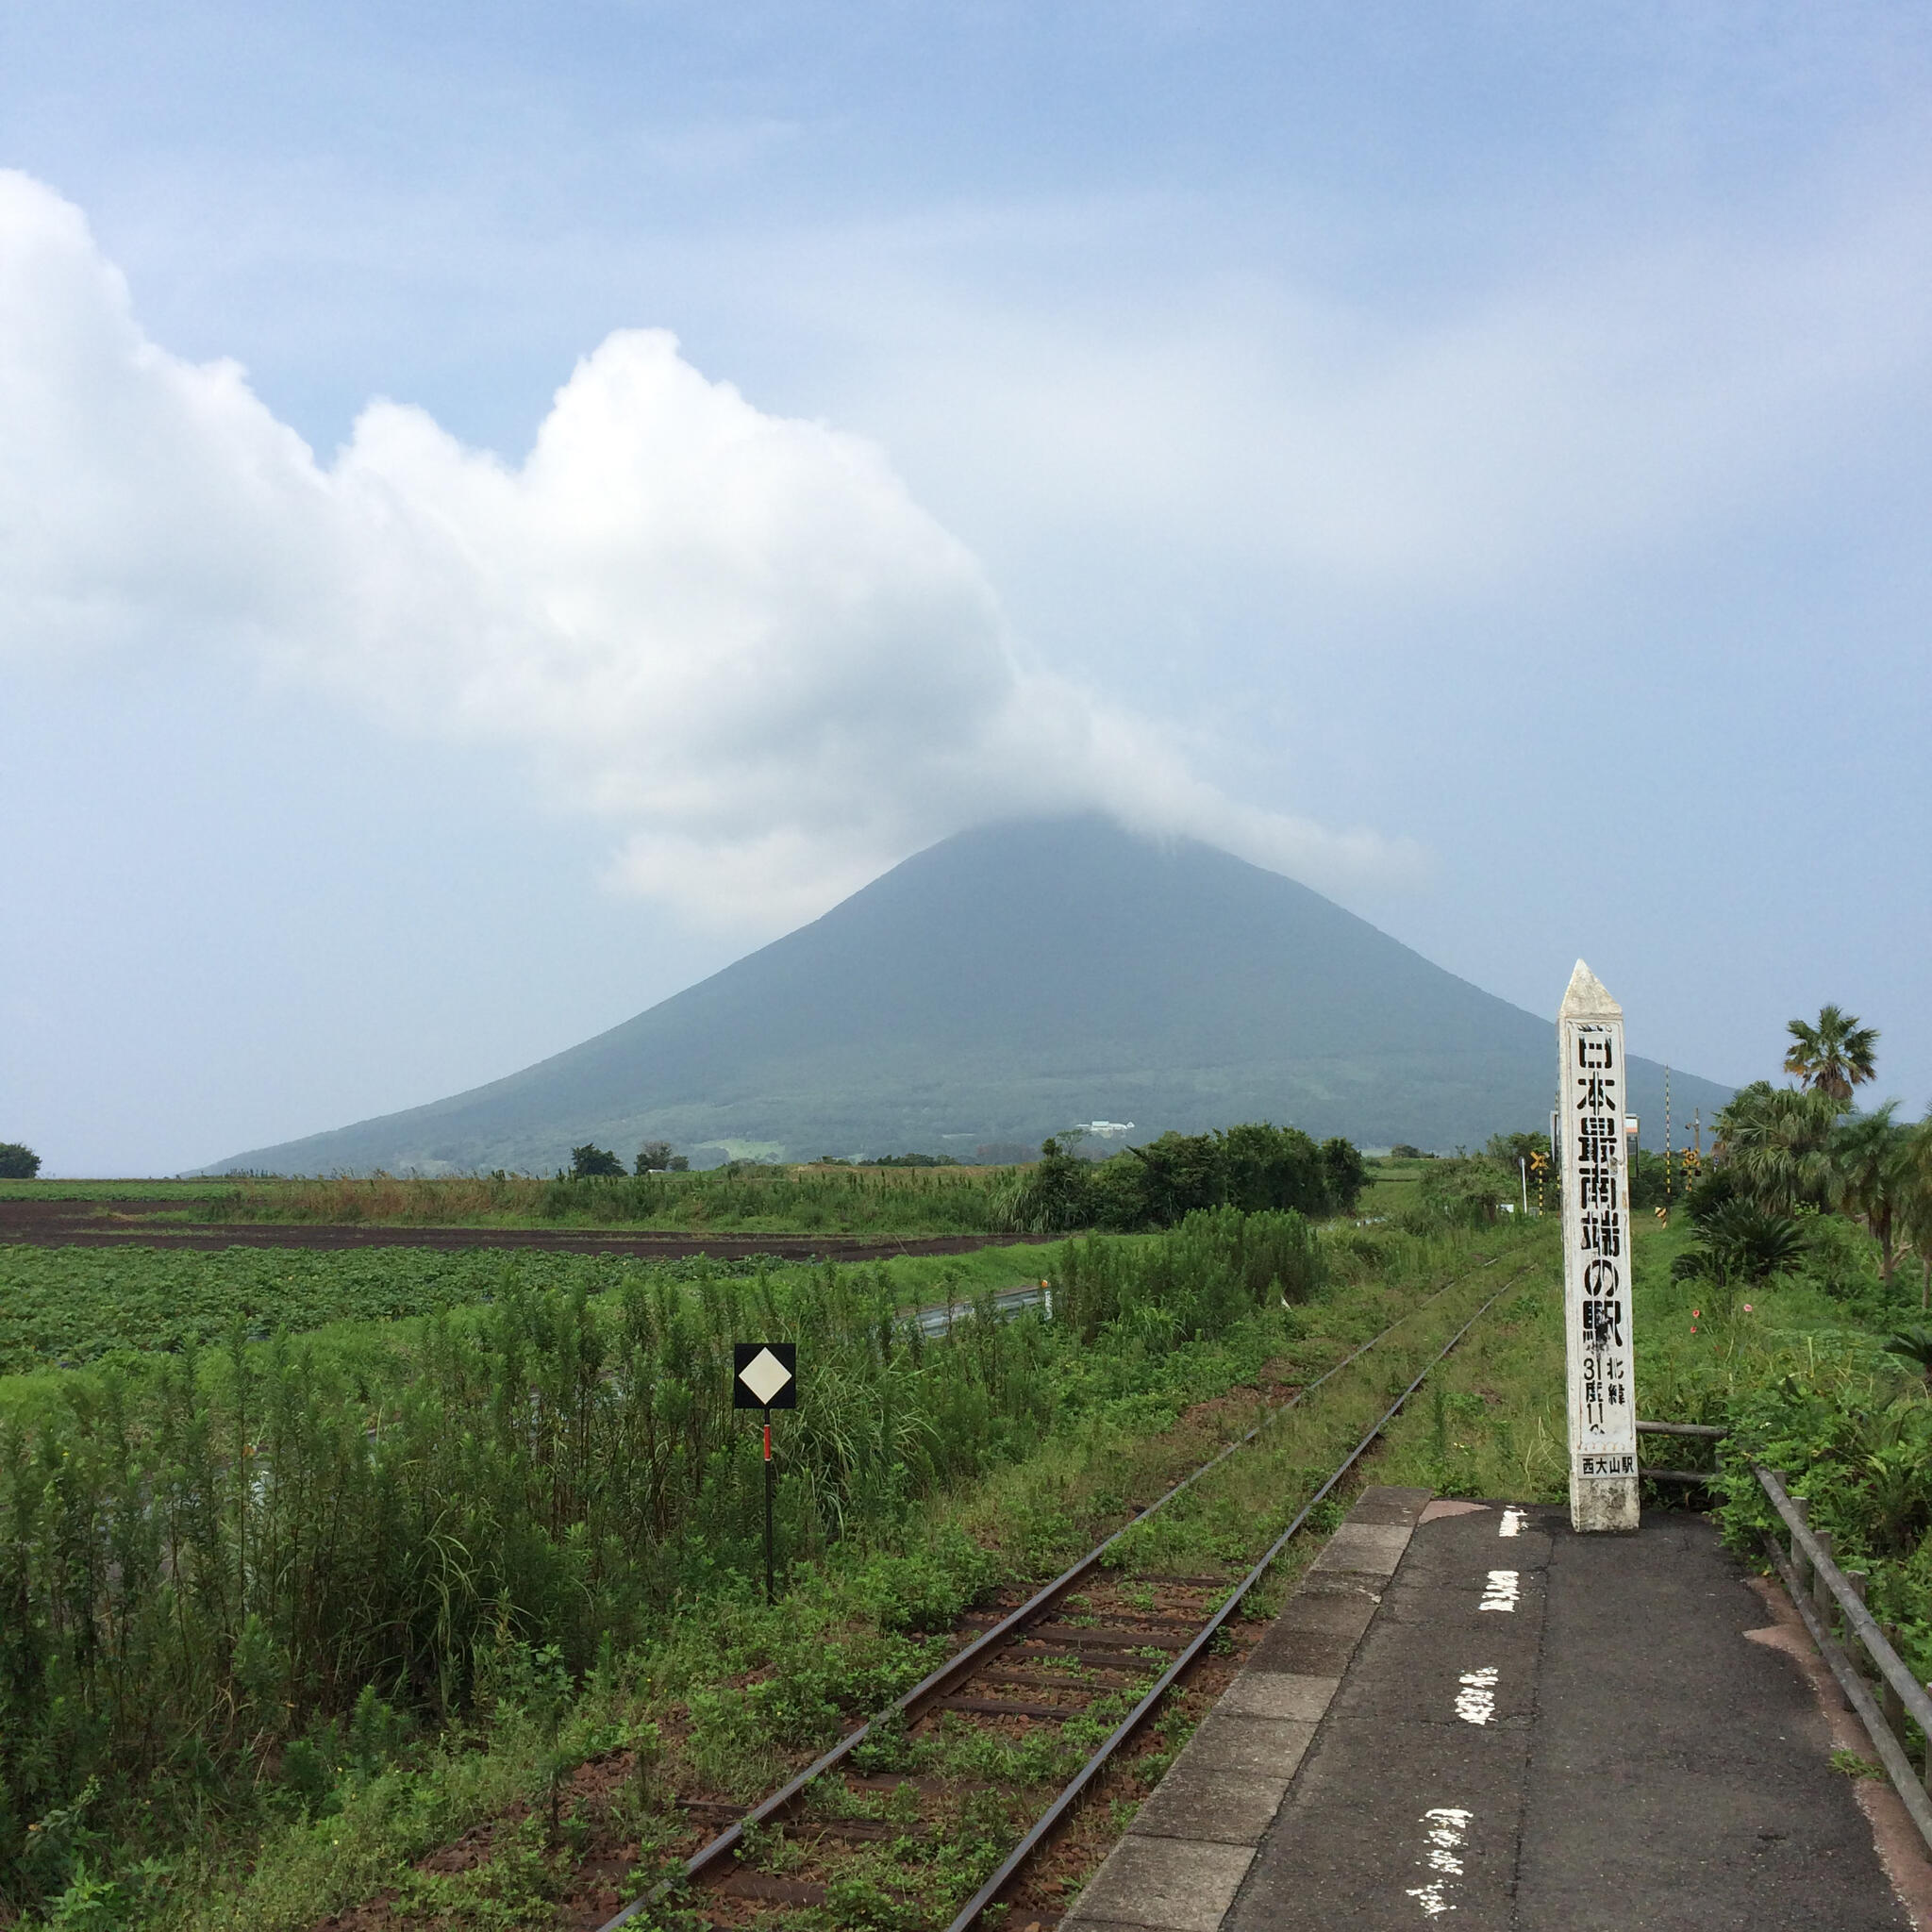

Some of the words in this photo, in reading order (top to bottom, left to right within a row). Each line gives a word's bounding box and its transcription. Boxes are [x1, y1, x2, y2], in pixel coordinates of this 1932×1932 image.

[1577, 1027, 1623, 1347] 日本最南端の駅
[1607, 1357, 1625, 1405] 北緯
[1582, 1456, 1634, 1474] 西大山駅
